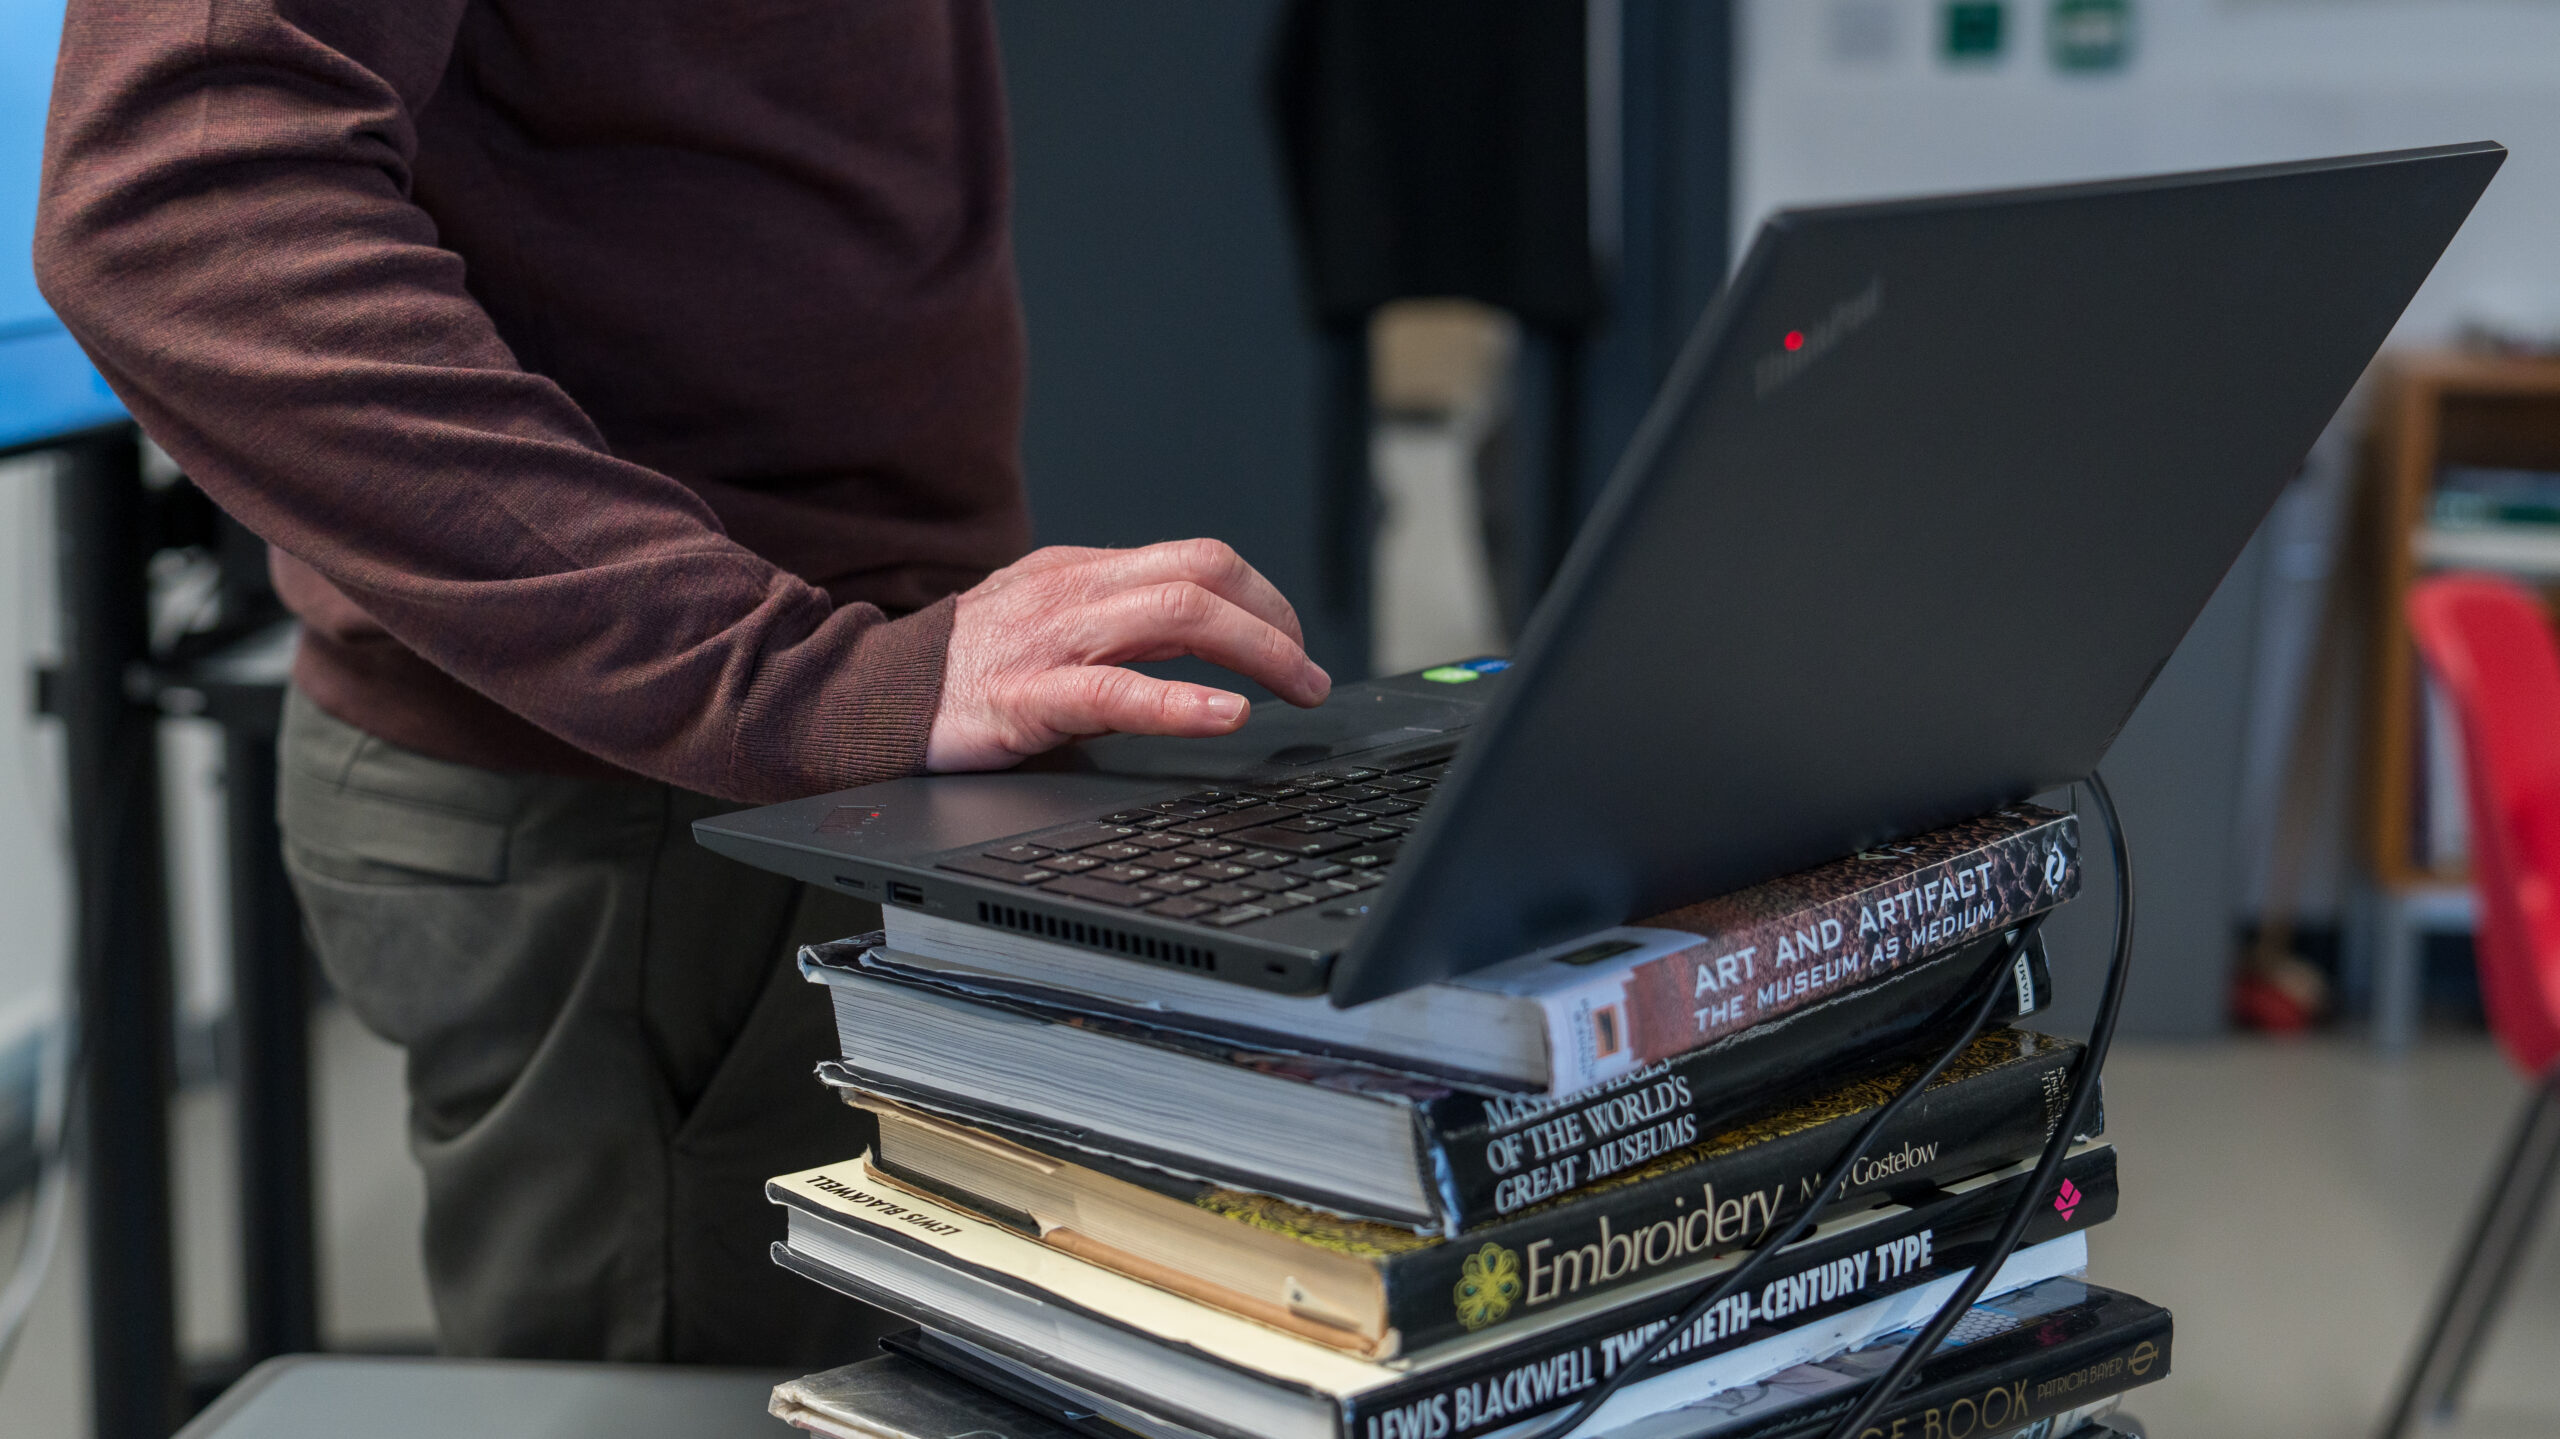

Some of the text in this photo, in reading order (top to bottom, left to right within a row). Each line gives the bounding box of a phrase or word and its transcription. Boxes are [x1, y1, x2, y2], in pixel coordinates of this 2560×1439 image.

[1694, 861, 1993, 998] ART AND ARTIFACT
[1694, 900, 1995, 1032] THE MUSEUM AS MEDIUM
[1486, 1131, 1523, 1175] OF
[1523, 1112, 1587, 1161] THE
[1583, 1074, 1692, 1138] WORLD'S
[1494, 1112, 1698, 1215] GREAT MUSEUMS
[805, 1174, 963, 1237] LEWIS BLACKWELL
[1526, 1140, 1940, 1306] Embroidery My Gostelow
[1366, 1392, 1449, 1439] LEWIS
[1454, 1345, 1597, 1433] BLACKWELL
[1875, 1228, 1934, 1283] TYPE
[1923, 1378, 2030, 1439] BOOK
[2037, 1368, 2088, 1401] PATRICIA
[2089, 1357, 2124, 1385] BAYER
